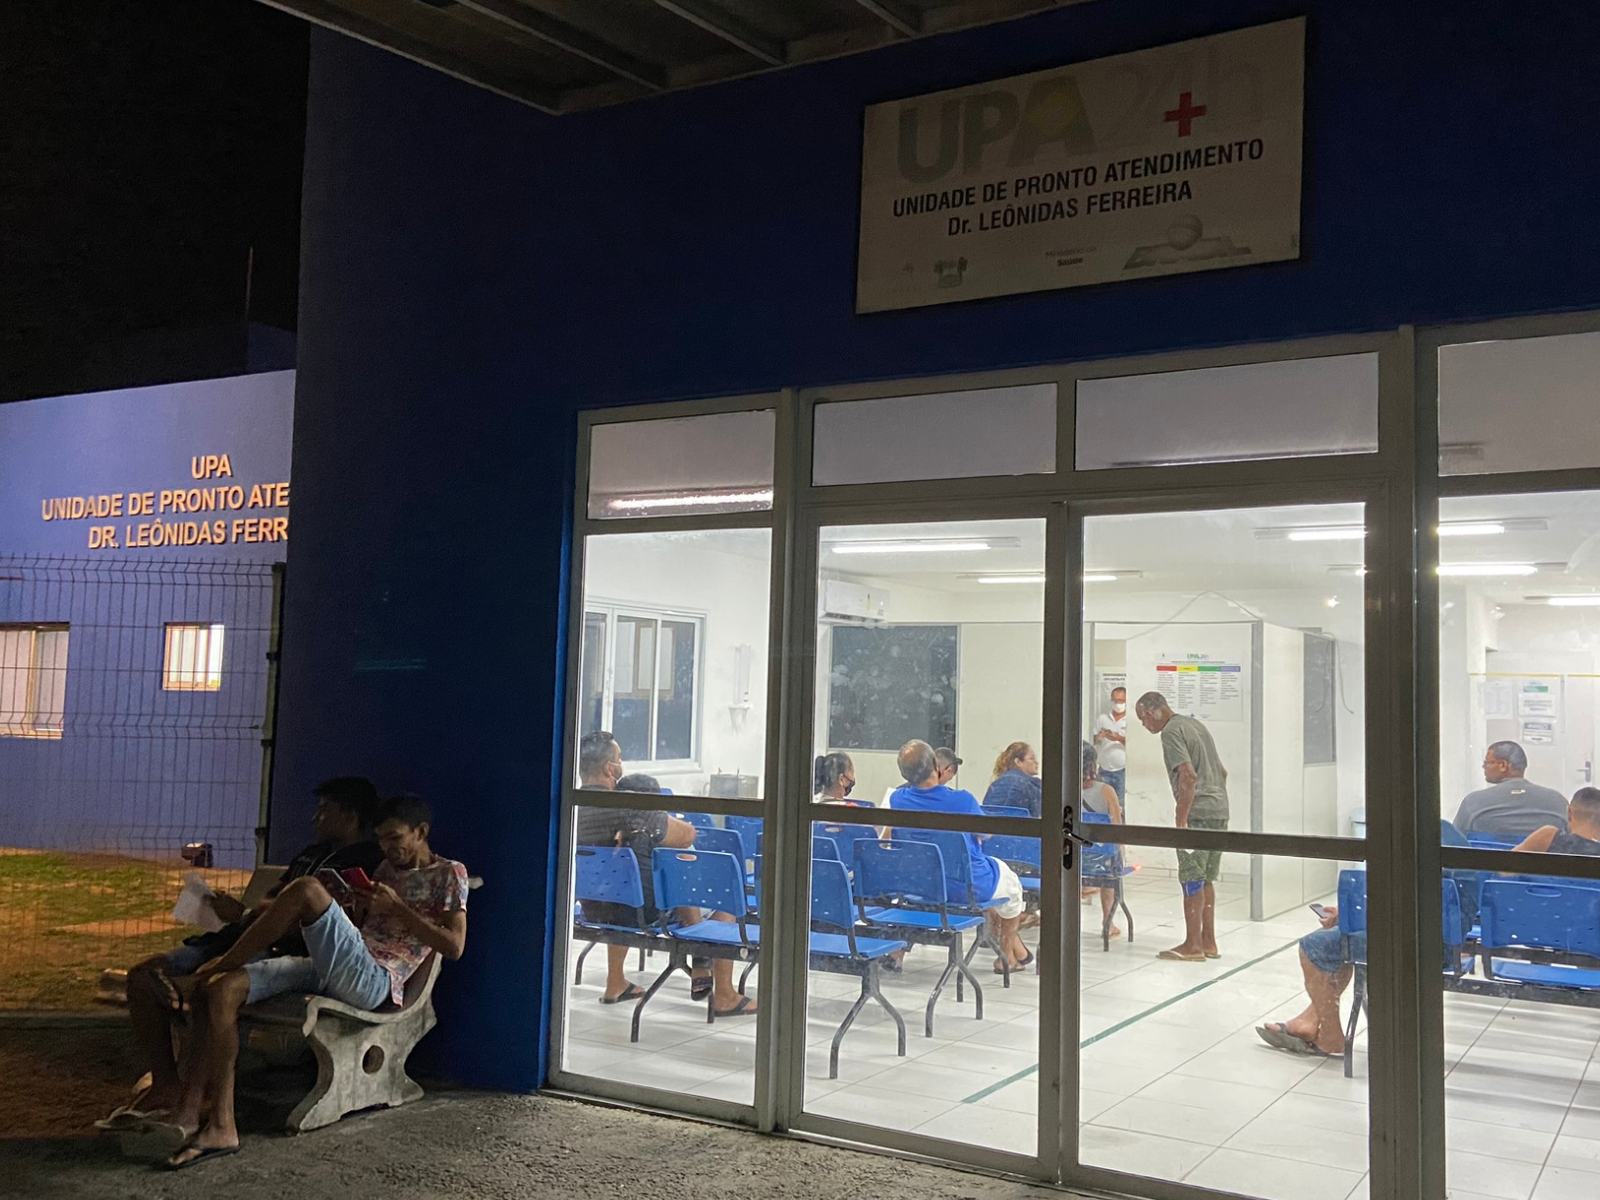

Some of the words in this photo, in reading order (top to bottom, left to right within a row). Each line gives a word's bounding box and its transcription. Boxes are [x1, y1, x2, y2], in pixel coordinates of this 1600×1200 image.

[897, 74, 1098, 184] UPA
[892, 187, 976, 217] UNIDADE
[982, 181, 1008, 204] DE
[1014, 166, 1098, 198] PRONTO
[1104, 138, 1264, 184] ATENDIMENTO
[948, 216, 972, 236] Dr.
[979, 198, 1078, 231] LEÔNIDAS
[1086, 180, 1193, 215] FERREIRA
[191, 454, 233, 479] UPA
[41, 493, 124, 521] UNIDADE
[128, 492, 154, 516] DE
[159, 486, 244, 513] PRONTO
[248, 482, 290, 507] ATE
[88, 526, 119, 549] DR.
[125, 518, 225, 548] LEÔNIDAS
[232, 517, 289, 543] FERR
